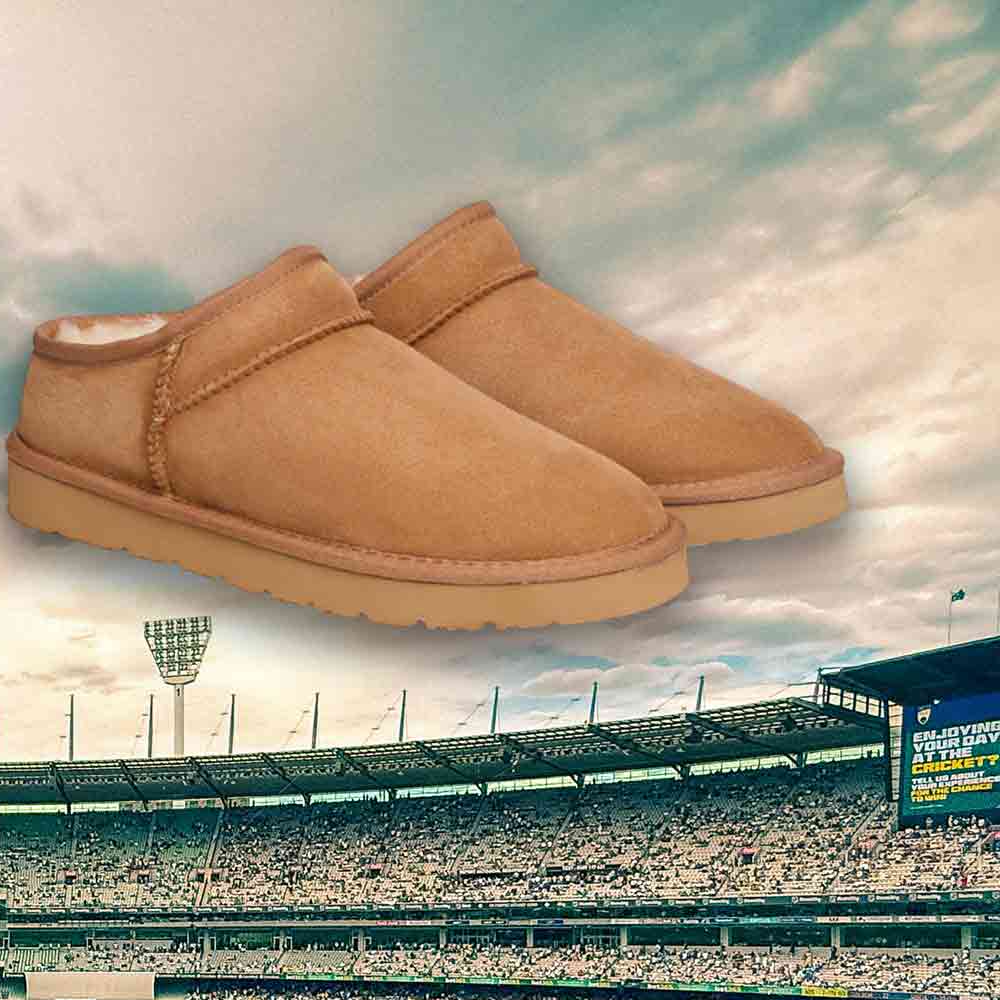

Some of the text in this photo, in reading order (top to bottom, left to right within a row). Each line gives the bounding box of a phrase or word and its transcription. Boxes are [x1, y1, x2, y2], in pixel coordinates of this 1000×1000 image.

[913, 721, 1000, 742] ENJOYING
[913, 732, 1000, 752] YOUR DAY
[912, 747, 972, 763] AT THE
[912, 754, 1000, 774] CRICKET?
[912, 777, 934, 785] TELL
[950, 771, 985, 780] ABOUT
[912, 782, 937, 790] YOUR
[932, 787, 949, 795] THE
[951, 783, 992, 793] CHANCE
